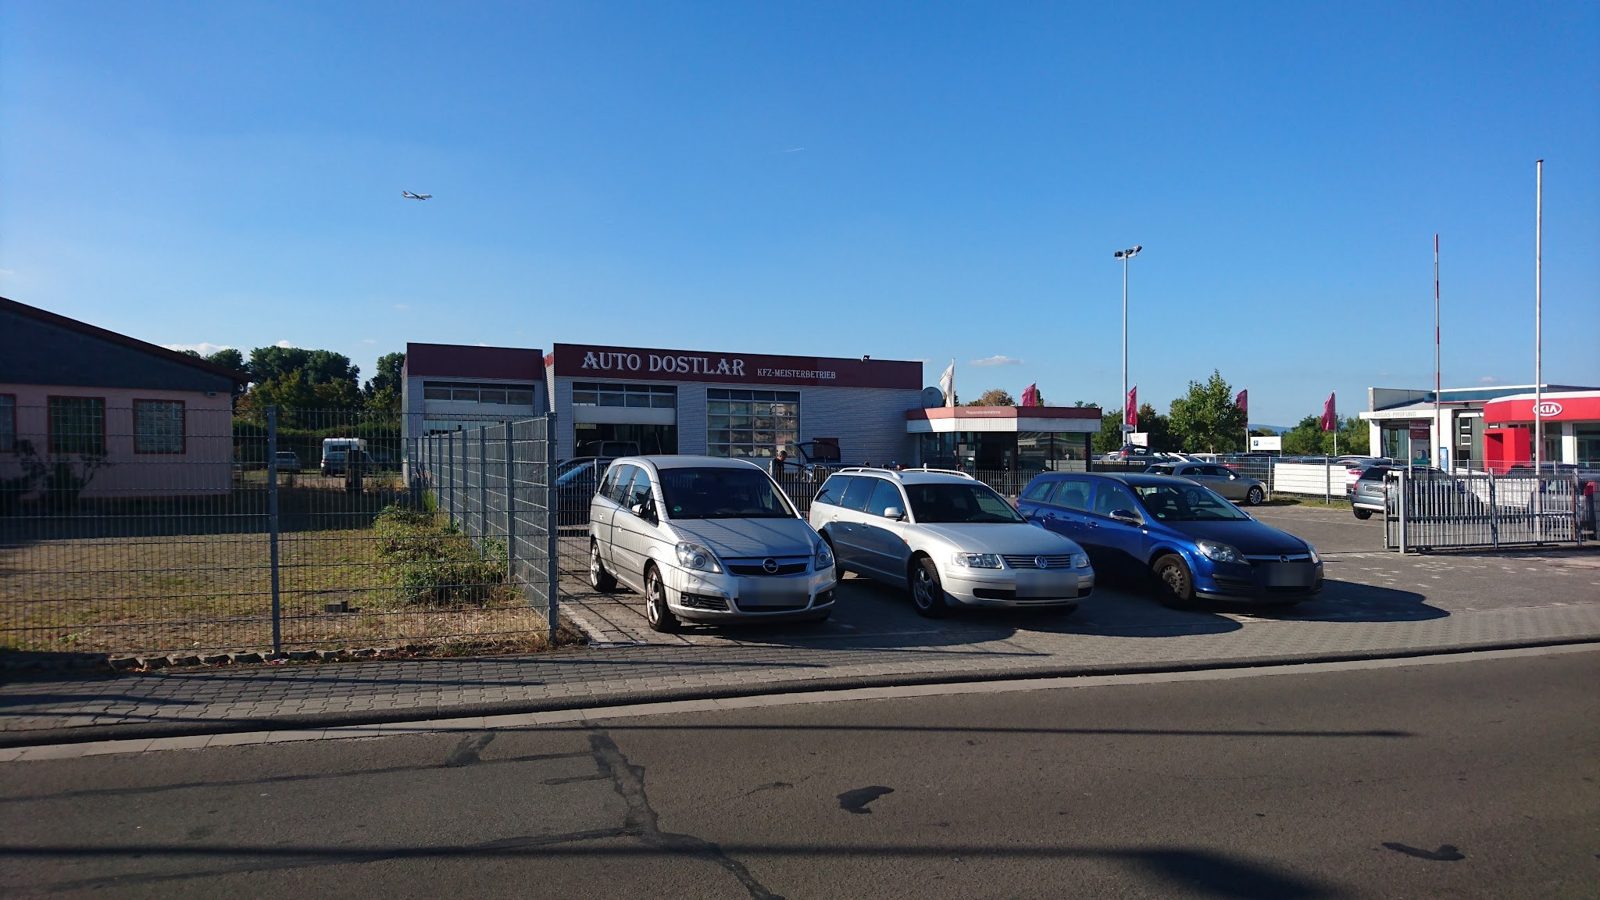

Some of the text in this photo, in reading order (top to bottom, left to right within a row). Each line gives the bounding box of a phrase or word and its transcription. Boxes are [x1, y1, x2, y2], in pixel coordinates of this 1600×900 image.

[581, 351, 746, 377] AUTO DOSTLAR
[757, 368, 836, 379] KFZ-MEISTERBETRIEB
[1537, 404, 1558, 413] KIA
